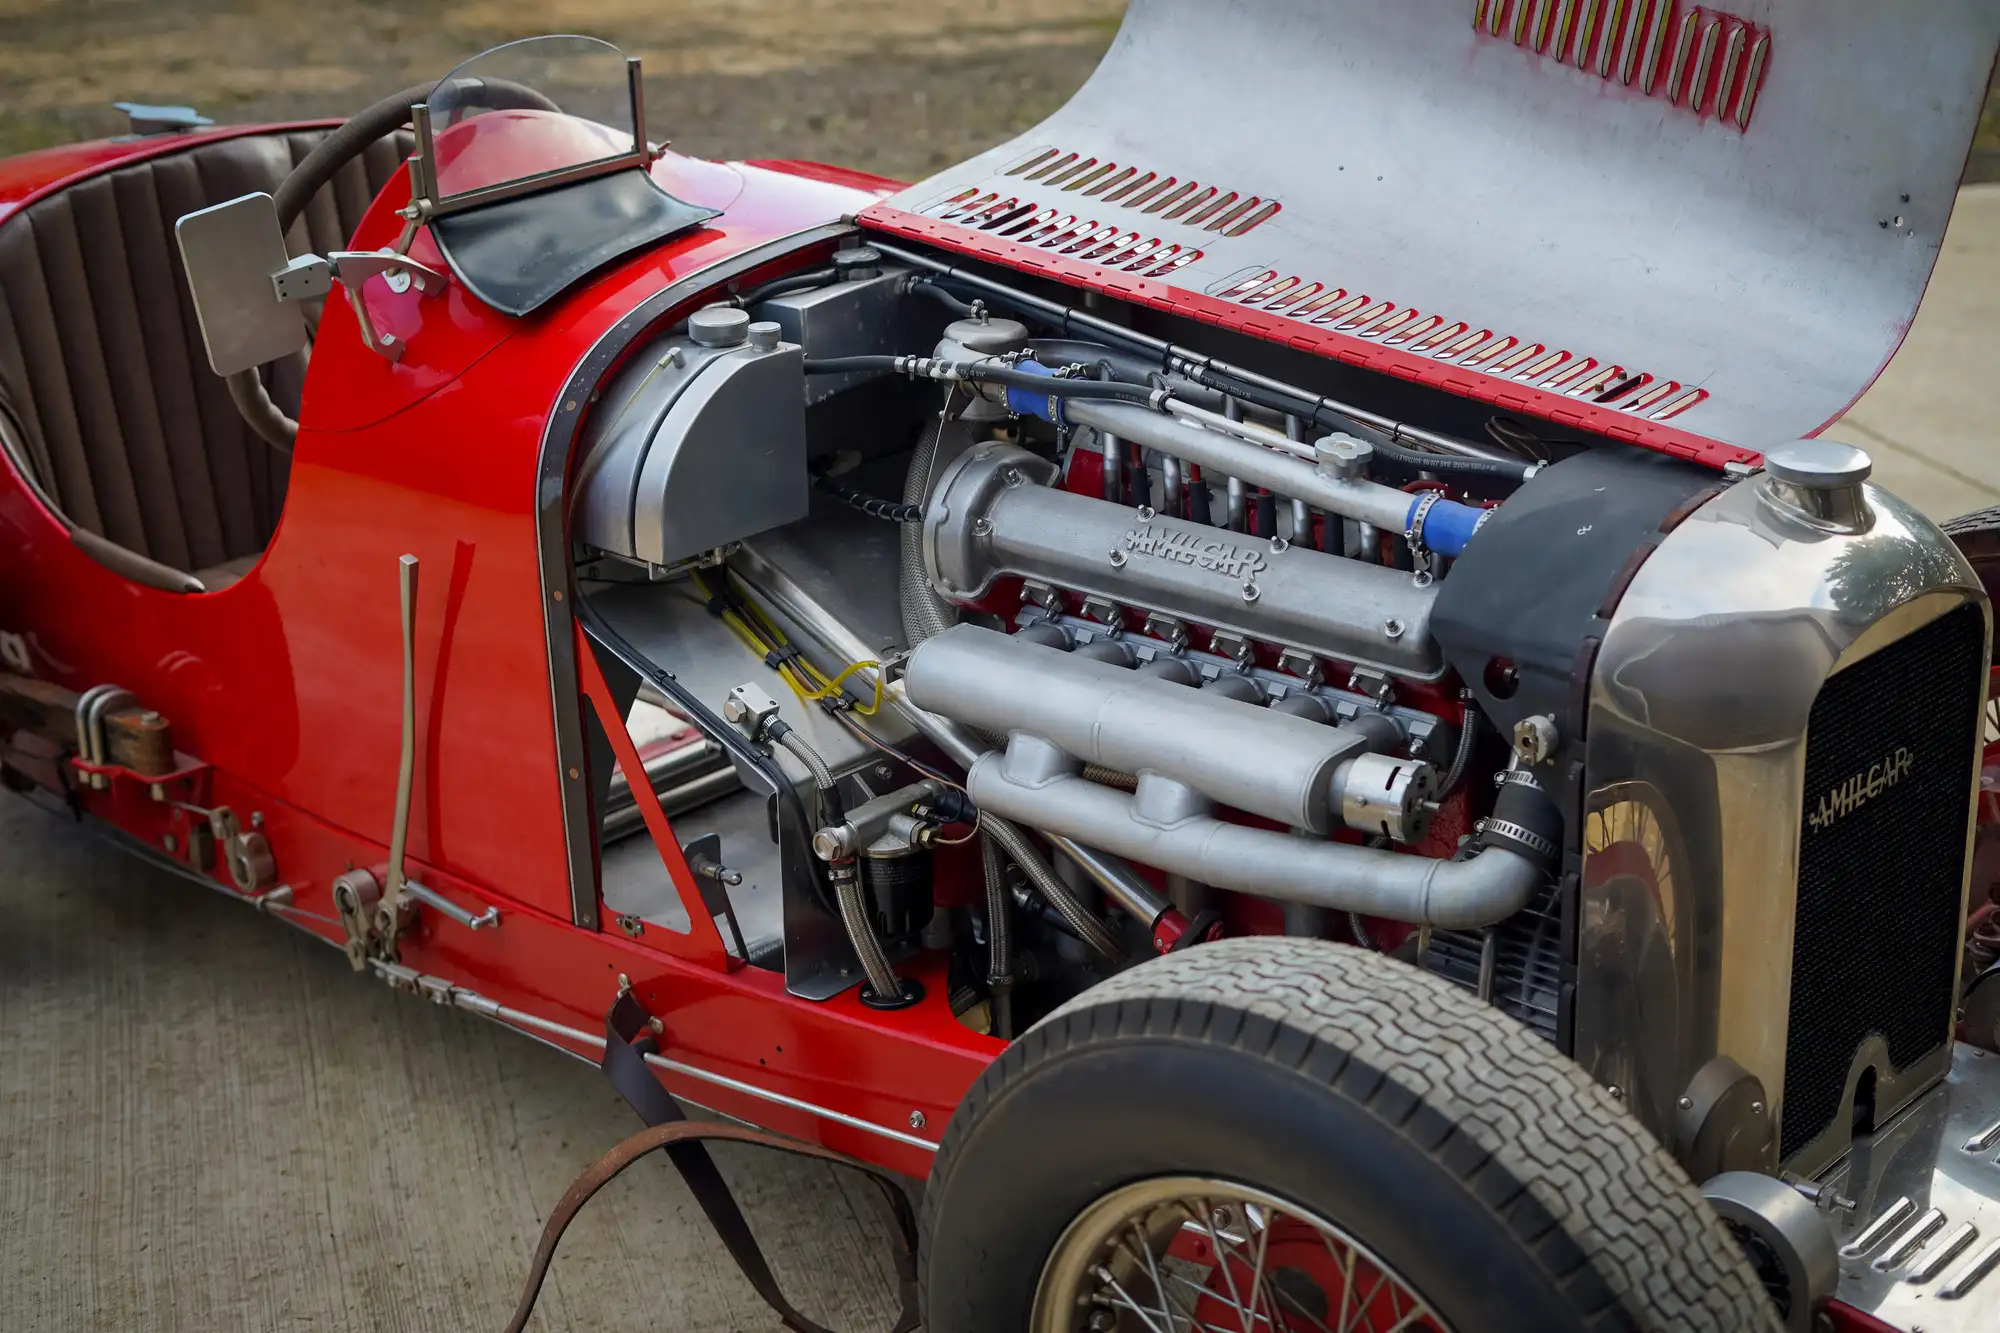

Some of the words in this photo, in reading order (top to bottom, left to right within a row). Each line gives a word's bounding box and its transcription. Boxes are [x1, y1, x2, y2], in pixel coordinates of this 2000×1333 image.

[1440, 460, 1451, 468] SAE
[1453, 461, 1470, 469] HOSE
[1126, 526, 1268, 582] AMILCAR
[1809, 747, 1914, 834] AMILCAR
